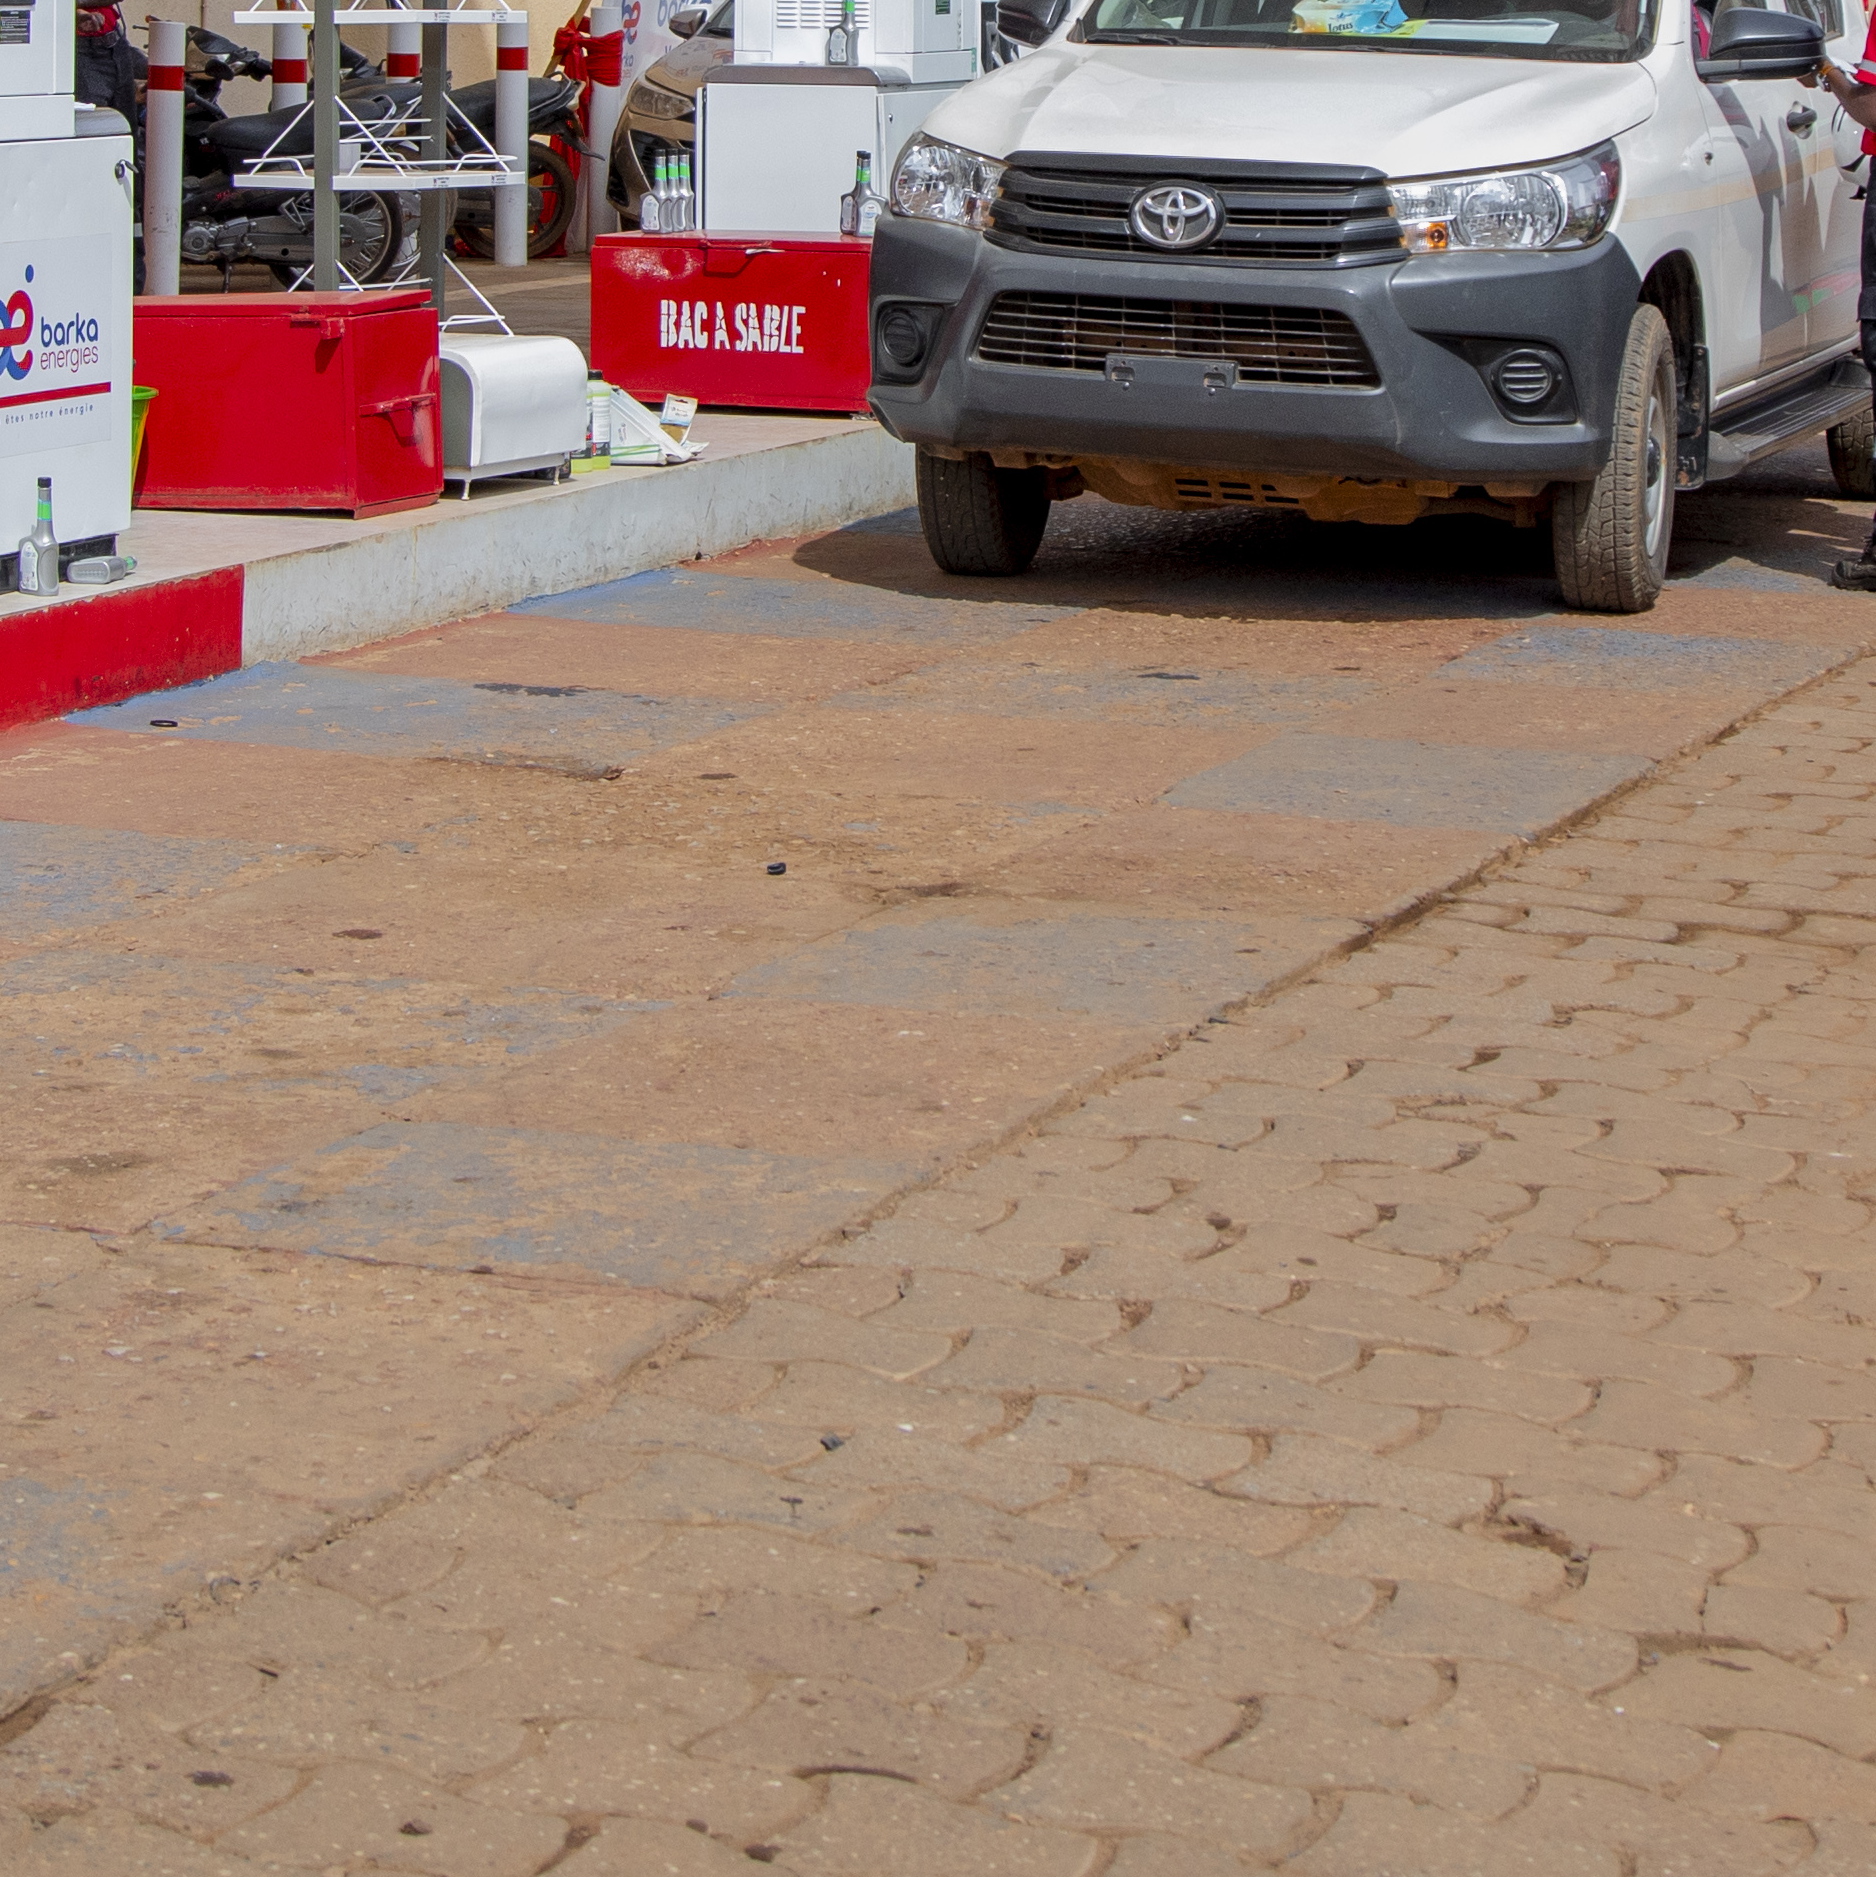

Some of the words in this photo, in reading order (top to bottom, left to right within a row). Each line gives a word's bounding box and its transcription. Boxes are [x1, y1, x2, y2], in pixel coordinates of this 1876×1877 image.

[41, 312, 99, 348] barka
[660, 299, 709, 349] BAC
[714, 301, 731, 350] A
[734, 302, 807, 354] SABLE
[40, 345, 99, 373] energies
[5, 414, 25, 425] êtes
[29, 410, 54, 421] notre
[58, 402, 94, 417] énergie
